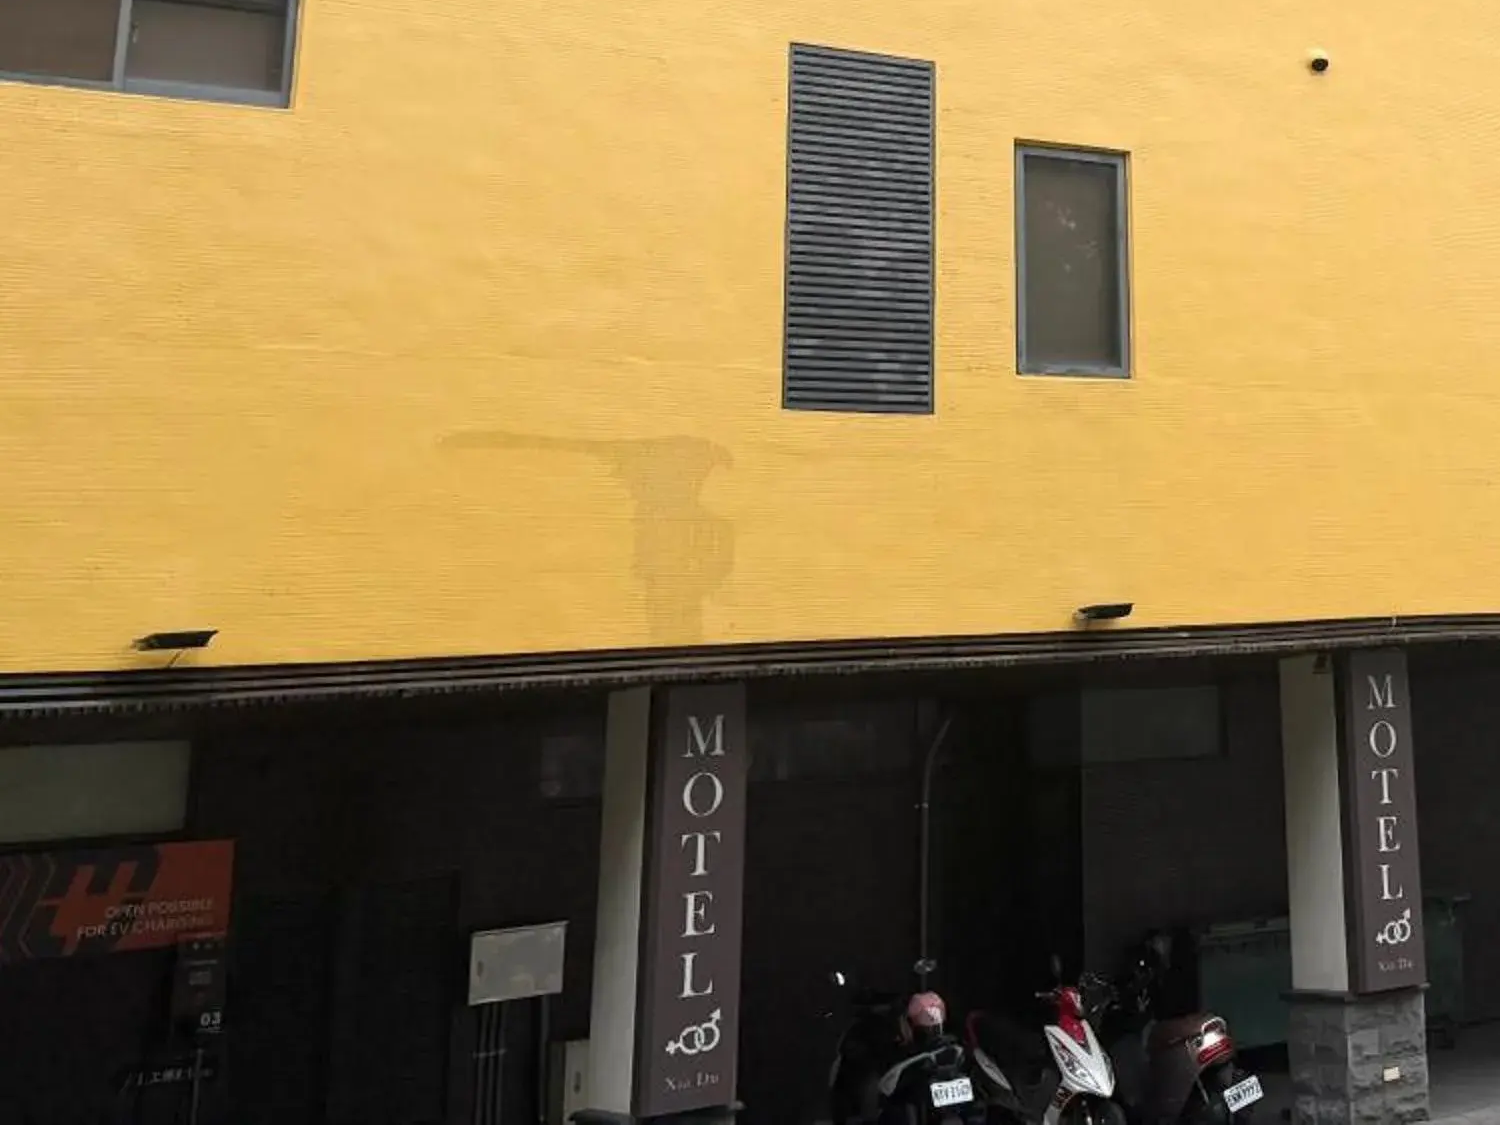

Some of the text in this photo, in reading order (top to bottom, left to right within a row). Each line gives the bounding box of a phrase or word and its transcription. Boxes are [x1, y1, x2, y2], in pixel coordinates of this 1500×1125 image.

[679, 714, 726, 999] MOTEL
[1367, 673, 1404, 900] MOTEL
[77, 923, 107, 939] FOR
